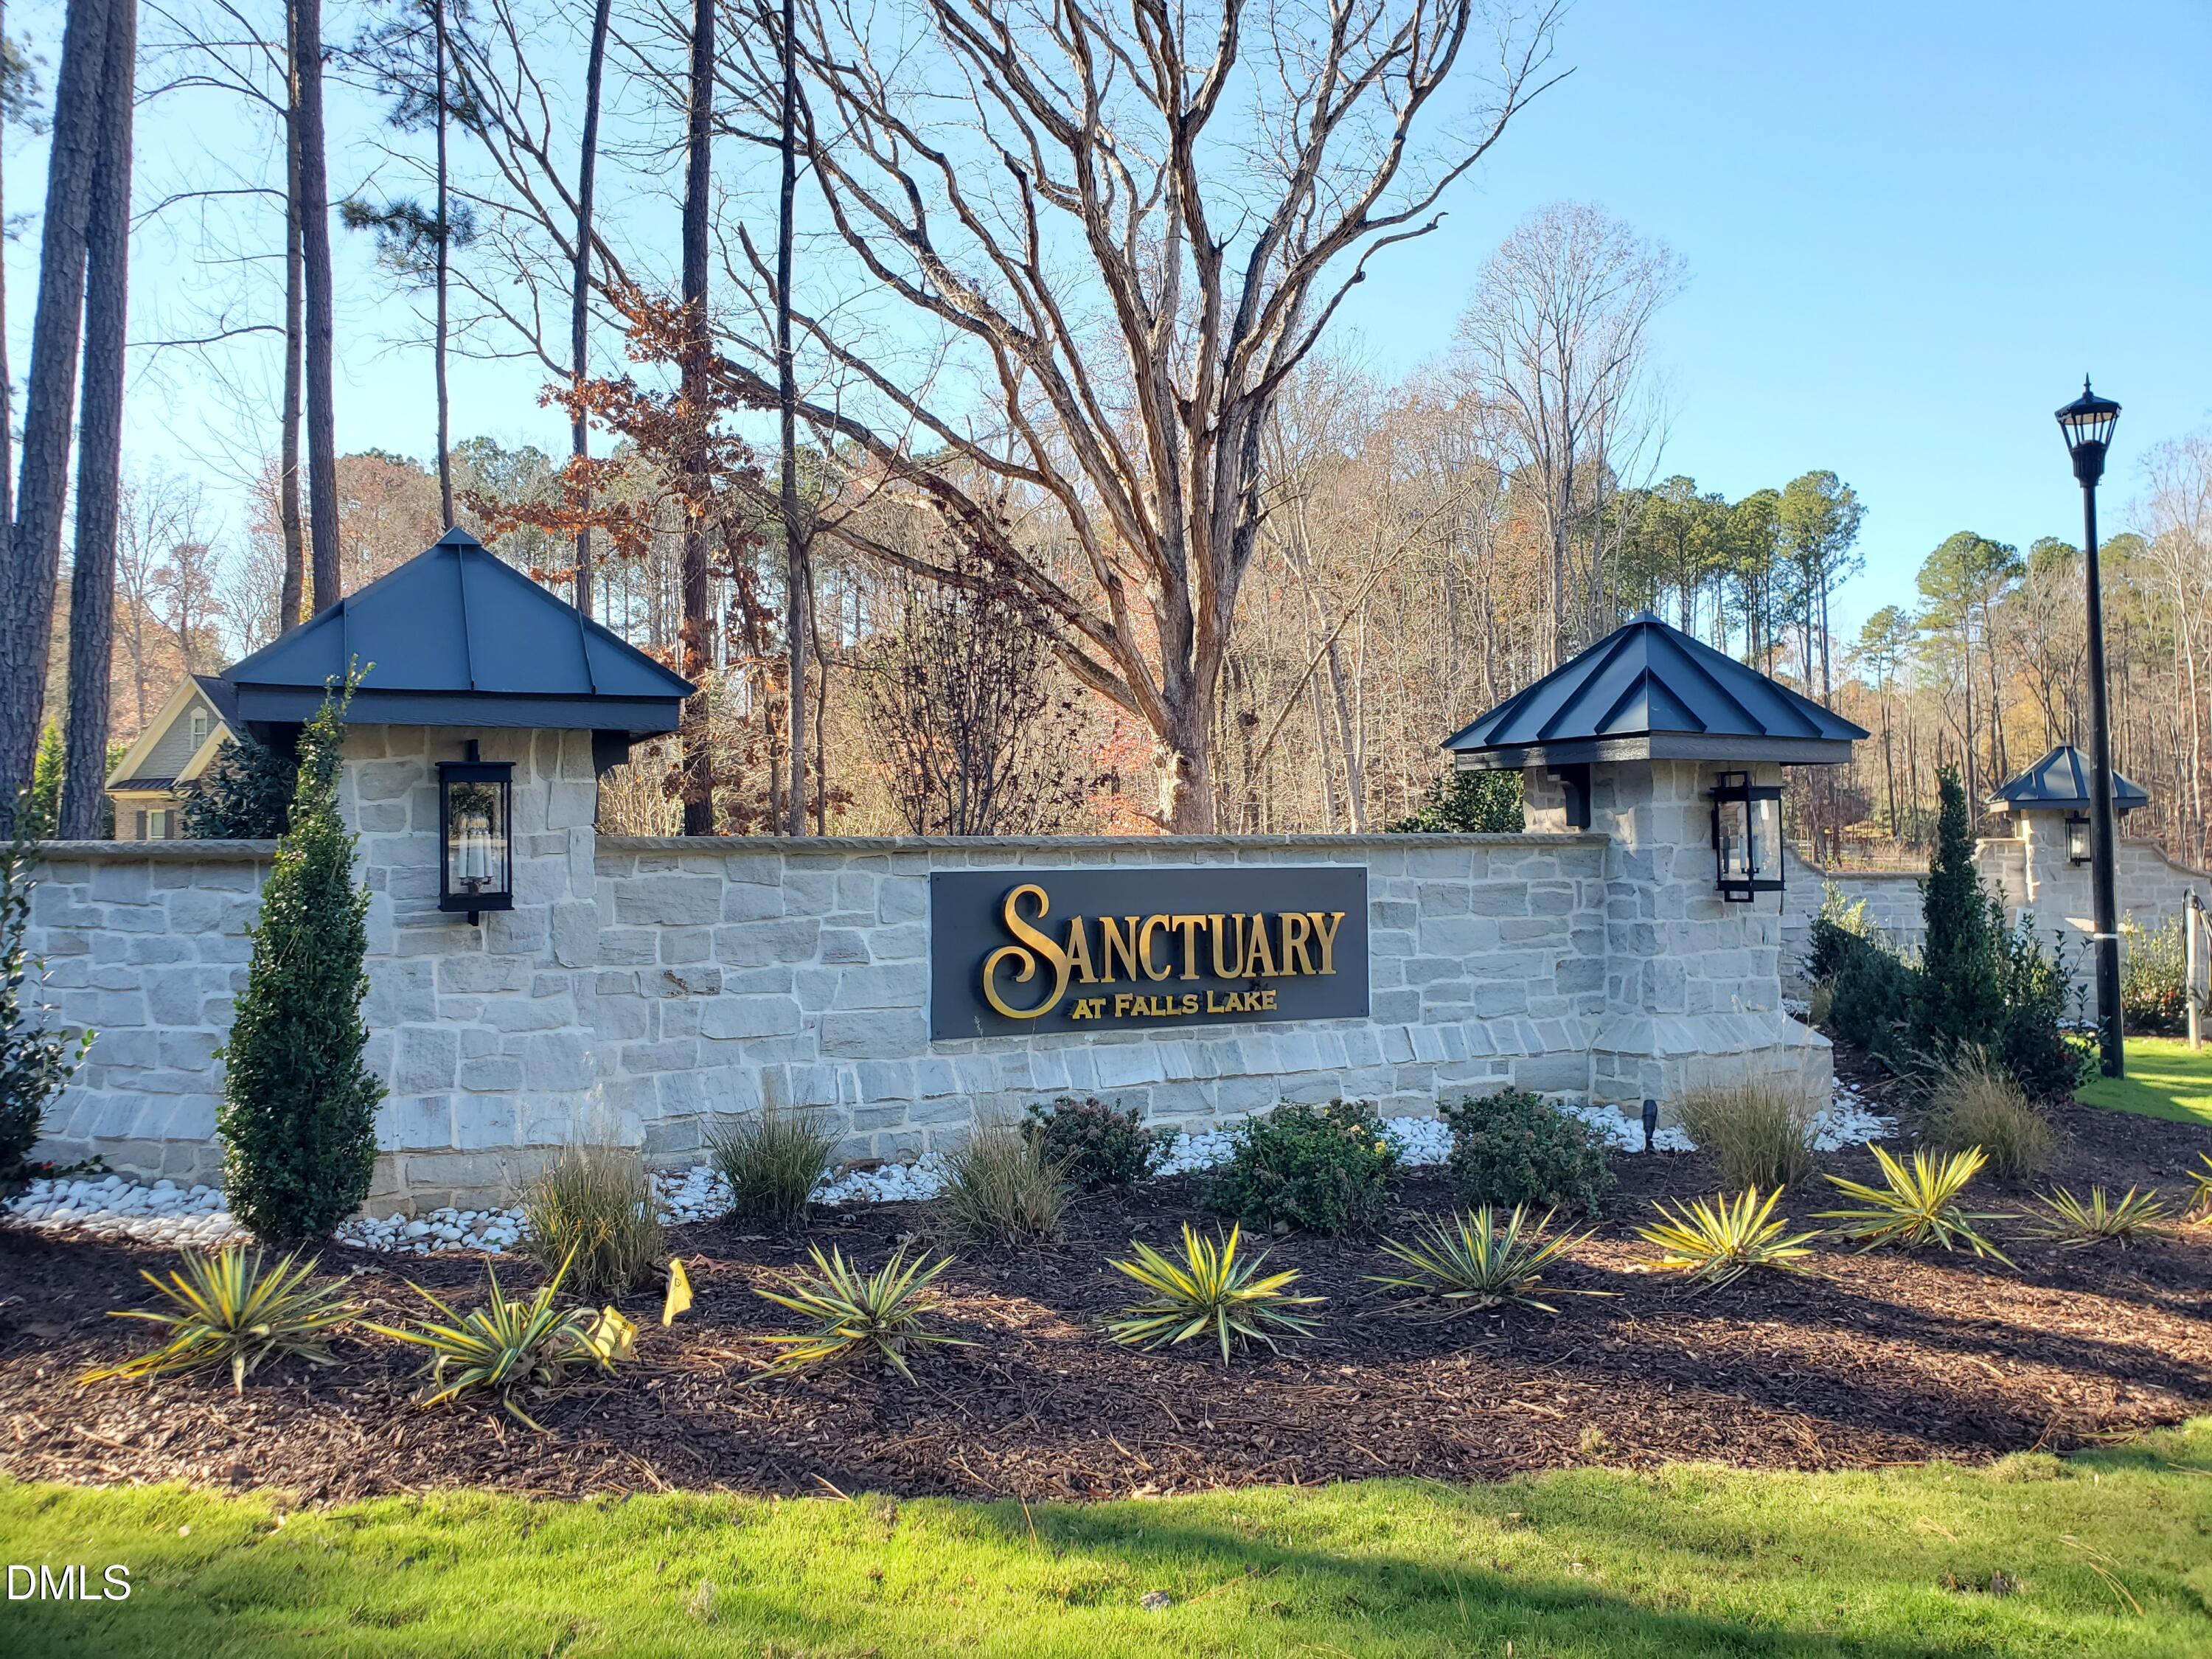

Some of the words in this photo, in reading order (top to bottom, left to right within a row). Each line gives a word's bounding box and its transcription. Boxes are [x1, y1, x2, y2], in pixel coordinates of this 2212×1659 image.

[982, 883, 1346, 1019] SANCTUARY
[1071, 998, 1106, 1019] AT
[1114, 992, 1199, 1018] FALLS
[1206, 990, 1277, 1014] LAKE
